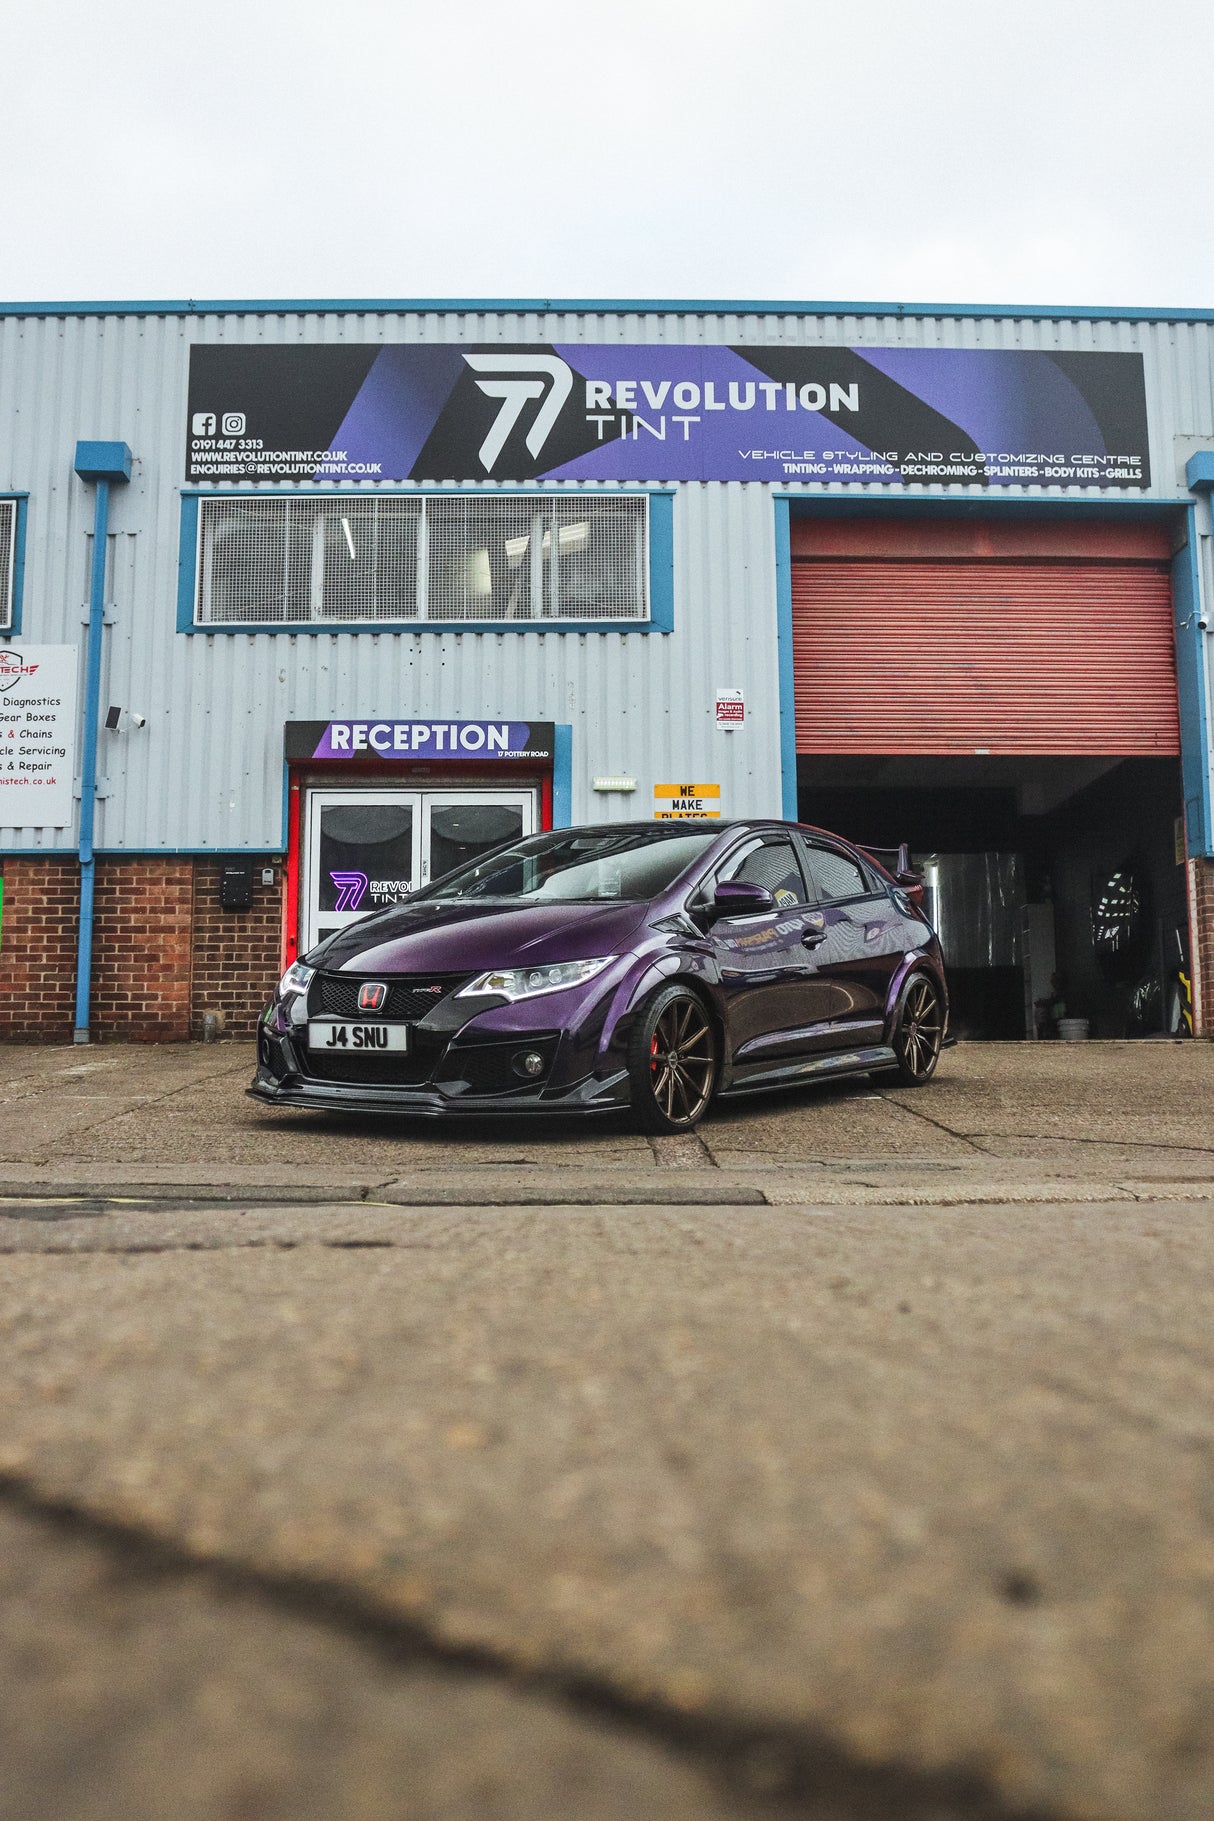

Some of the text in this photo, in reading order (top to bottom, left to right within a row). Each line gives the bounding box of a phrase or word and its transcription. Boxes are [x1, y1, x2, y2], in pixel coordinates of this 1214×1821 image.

[586, 380, 859, 412] REVOLUTION
[586, 415, 701, 441] TINT
[191, 440, 264, 450] 0191 447 3313
[191, 451, 349, 462] WWW.REVOLUTIONTINT.CO.UK
[738, 450, 1142, 465] VEHICLE STYLING AND CUSTOMIZING CENTRE
[190, 462, 382, 475] ENQUIRIES@REVOLUTIONTINT.CO.UK
[783, 463, 826, 474] TINTING
[833, 464, 894, 475] WRAPPING
[900, 464, 977, 476] DECHROMING
[983, 465, 1038, 477] SPLINTERS
[1045, 467, 1075, 478] BODY
[1076, 468, 1099, 478] KITS
[1105, 468, 1142, 478] GRILLS
[3, 697, 61, 708] Diagnostics
[26, 712, 56, 722] Boxes
[8, 730, 14, 739] &
[19, 729, 53, 739] Chains
[331, 724, 509, 751] RECEPTION
[18, 746, 66, 758] Servicing
[7, 761, 15, 771] &
[19, 761, 52, 773] Repair
[680, 786, 695, 797] WE
[672, 800, 703, 810] MAKE
[326, 1026, 388, 1048] J4 SNU
